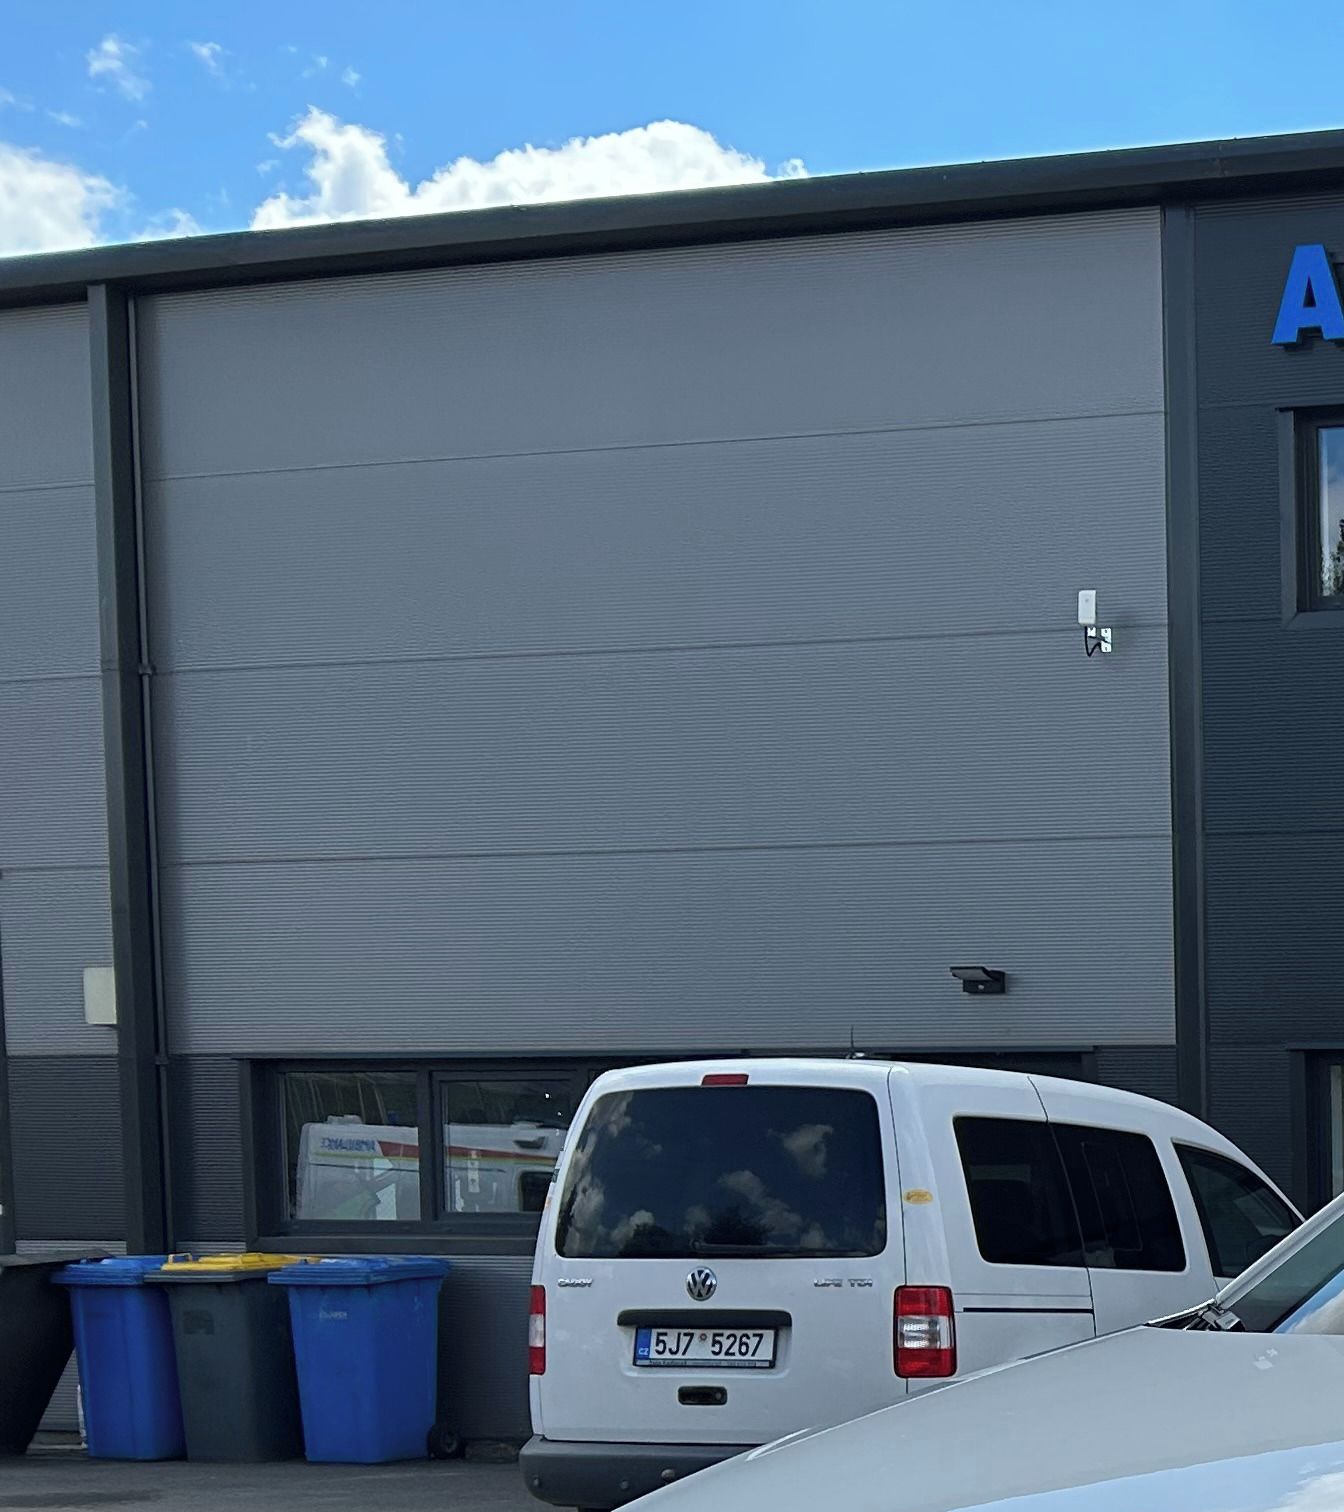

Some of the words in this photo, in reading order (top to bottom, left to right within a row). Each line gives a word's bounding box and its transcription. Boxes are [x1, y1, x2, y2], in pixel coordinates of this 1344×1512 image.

[638, 1347, 649, 1356] CZ
[654, 1331, 695, 1356] 5J7
[710, 1332, 764, 1357] 5267
